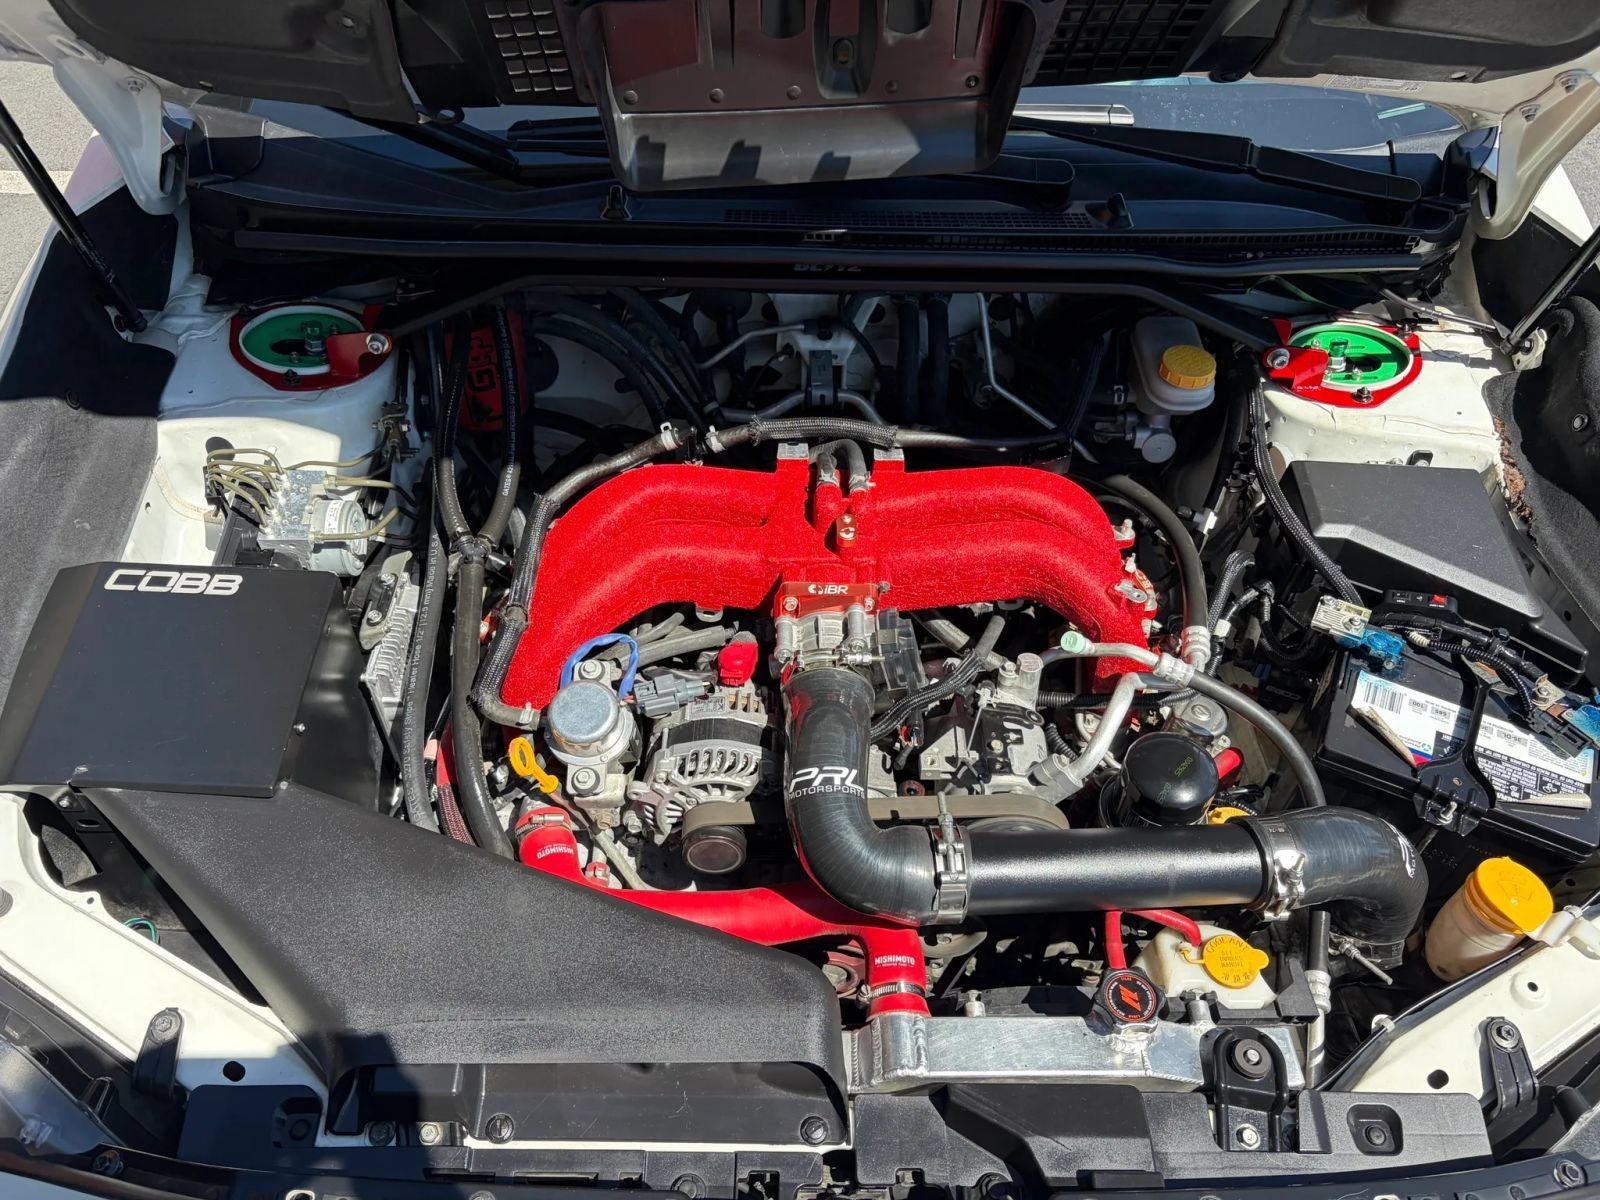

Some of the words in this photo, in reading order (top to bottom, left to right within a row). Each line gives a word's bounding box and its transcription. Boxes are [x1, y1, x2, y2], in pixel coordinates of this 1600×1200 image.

[104, 569, 243, 596] COBB
[425, 566, 436, 587] Made
[411, 644, 422, 666] Hose
[407, 667, 418, 694] Heater
[403, 727, 413, 754] Safety
[788, 766, 865, 793] PRL
[788, 785, 865, 800] MOTORSPORTS
[536, 845, 575, 860] MISHIMOTO
[874, 954, 916, 966] MISHIMOTO
